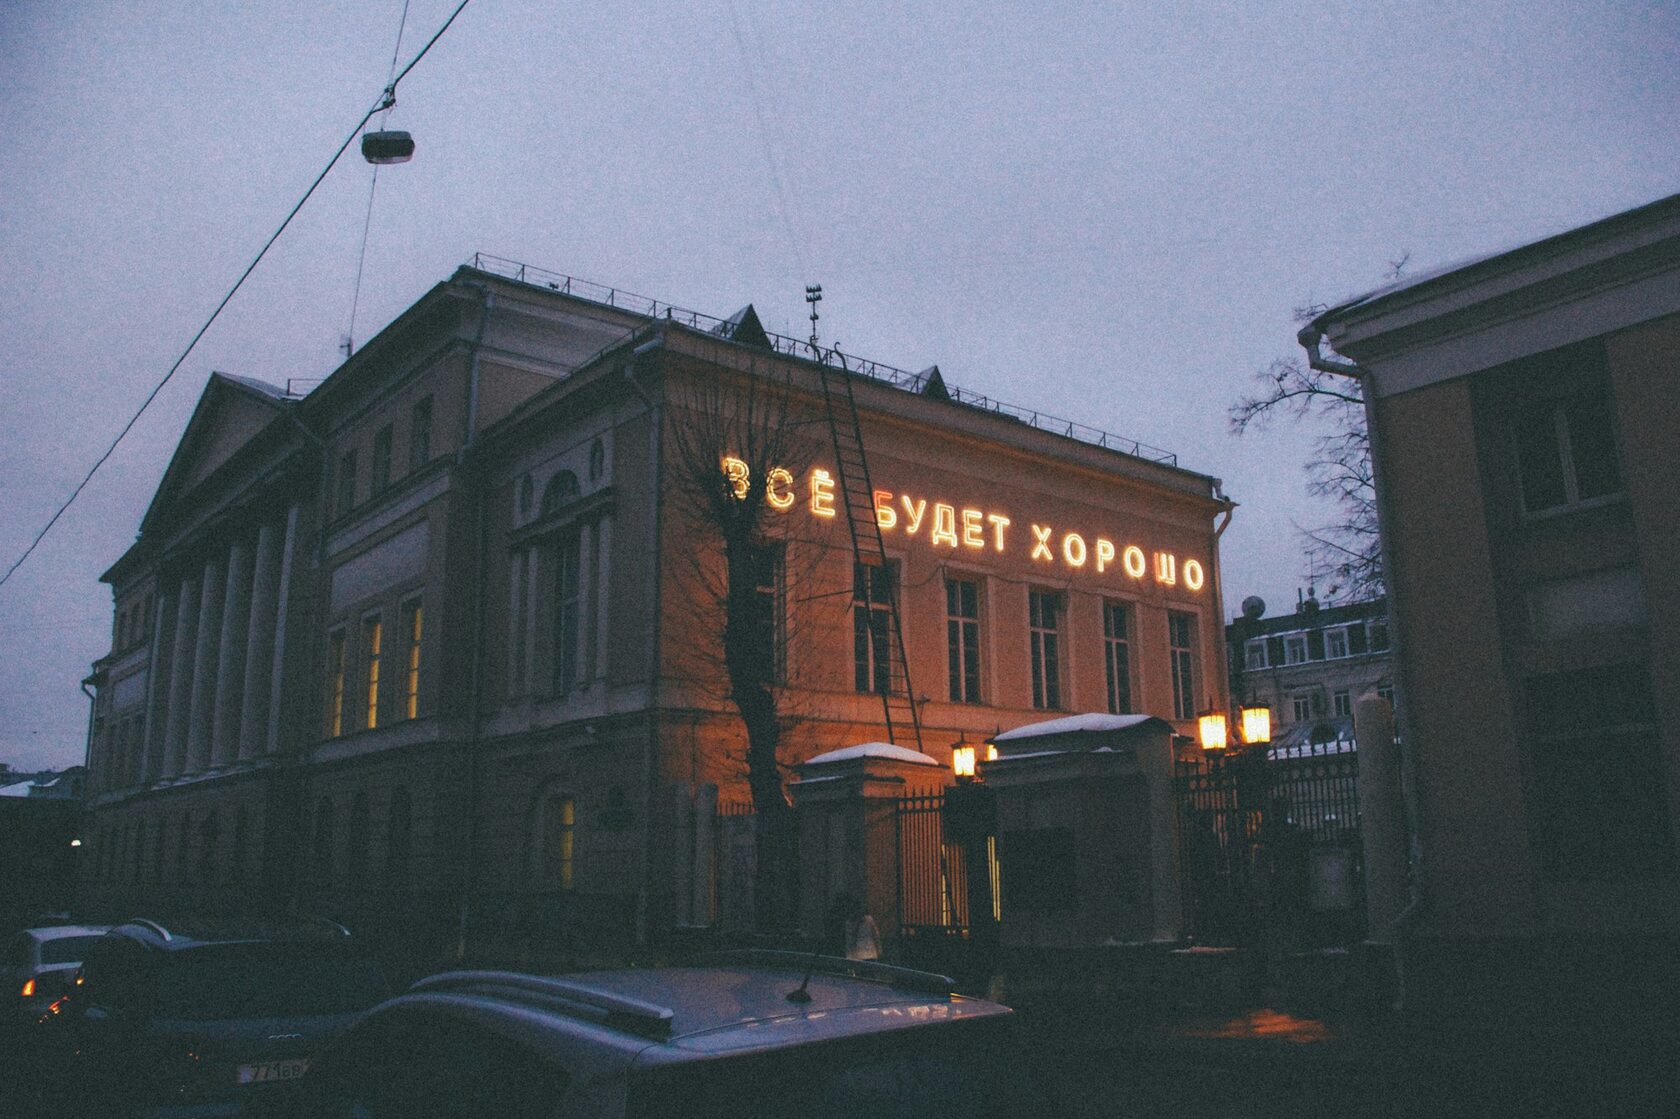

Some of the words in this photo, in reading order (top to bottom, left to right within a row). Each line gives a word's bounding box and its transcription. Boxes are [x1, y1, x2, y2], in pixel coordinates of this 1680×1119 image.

[720, 456, 836, 518] ВСЁ
[873, 489, 1012, 553] БУДЕТ
[1030, 523, 1205, 591] ХОРОШО
